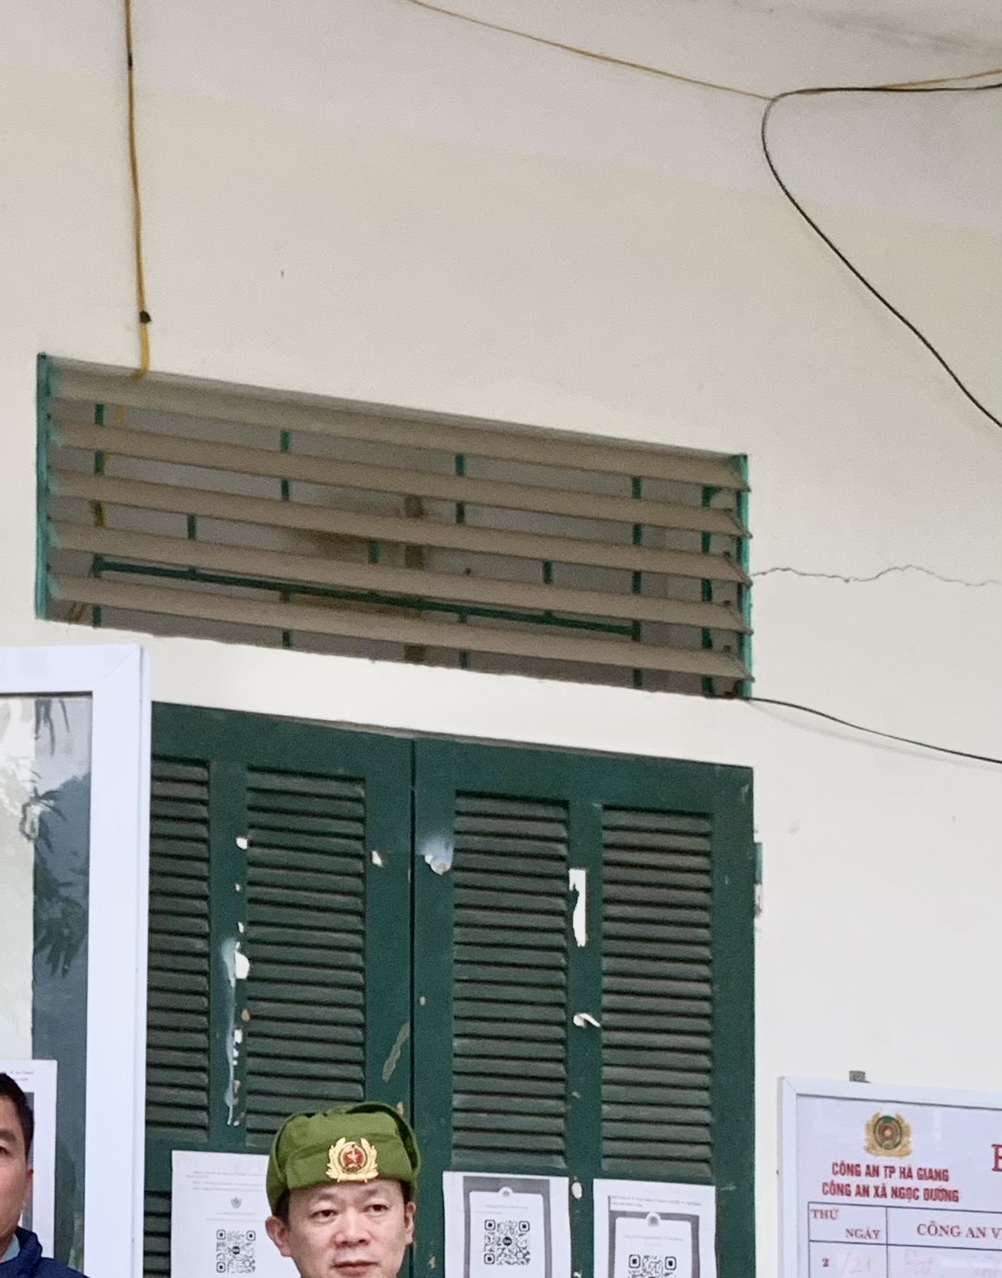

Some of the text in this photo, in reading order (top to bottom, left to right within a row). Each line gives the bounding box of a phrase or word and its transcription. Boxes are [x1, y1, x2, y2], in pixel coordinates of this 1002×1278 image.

[831, 1160, 862, 1177] CÔNG
[865, 1164, 880, 1179] AN
[883, 1165, 896, 1179] TP
[916, 1167, 950, 1182] GIANG
[821, 1180, 852, 1197] CÔNG
[855, 1184, 870, 1198] AN
[890, 1186, 920, 1203] NGỌC
[917, 1220, 961, 1238] CÔNG
[965, 1226, 987, 1238] AN
[821, 1258, 829, 1267] 2
